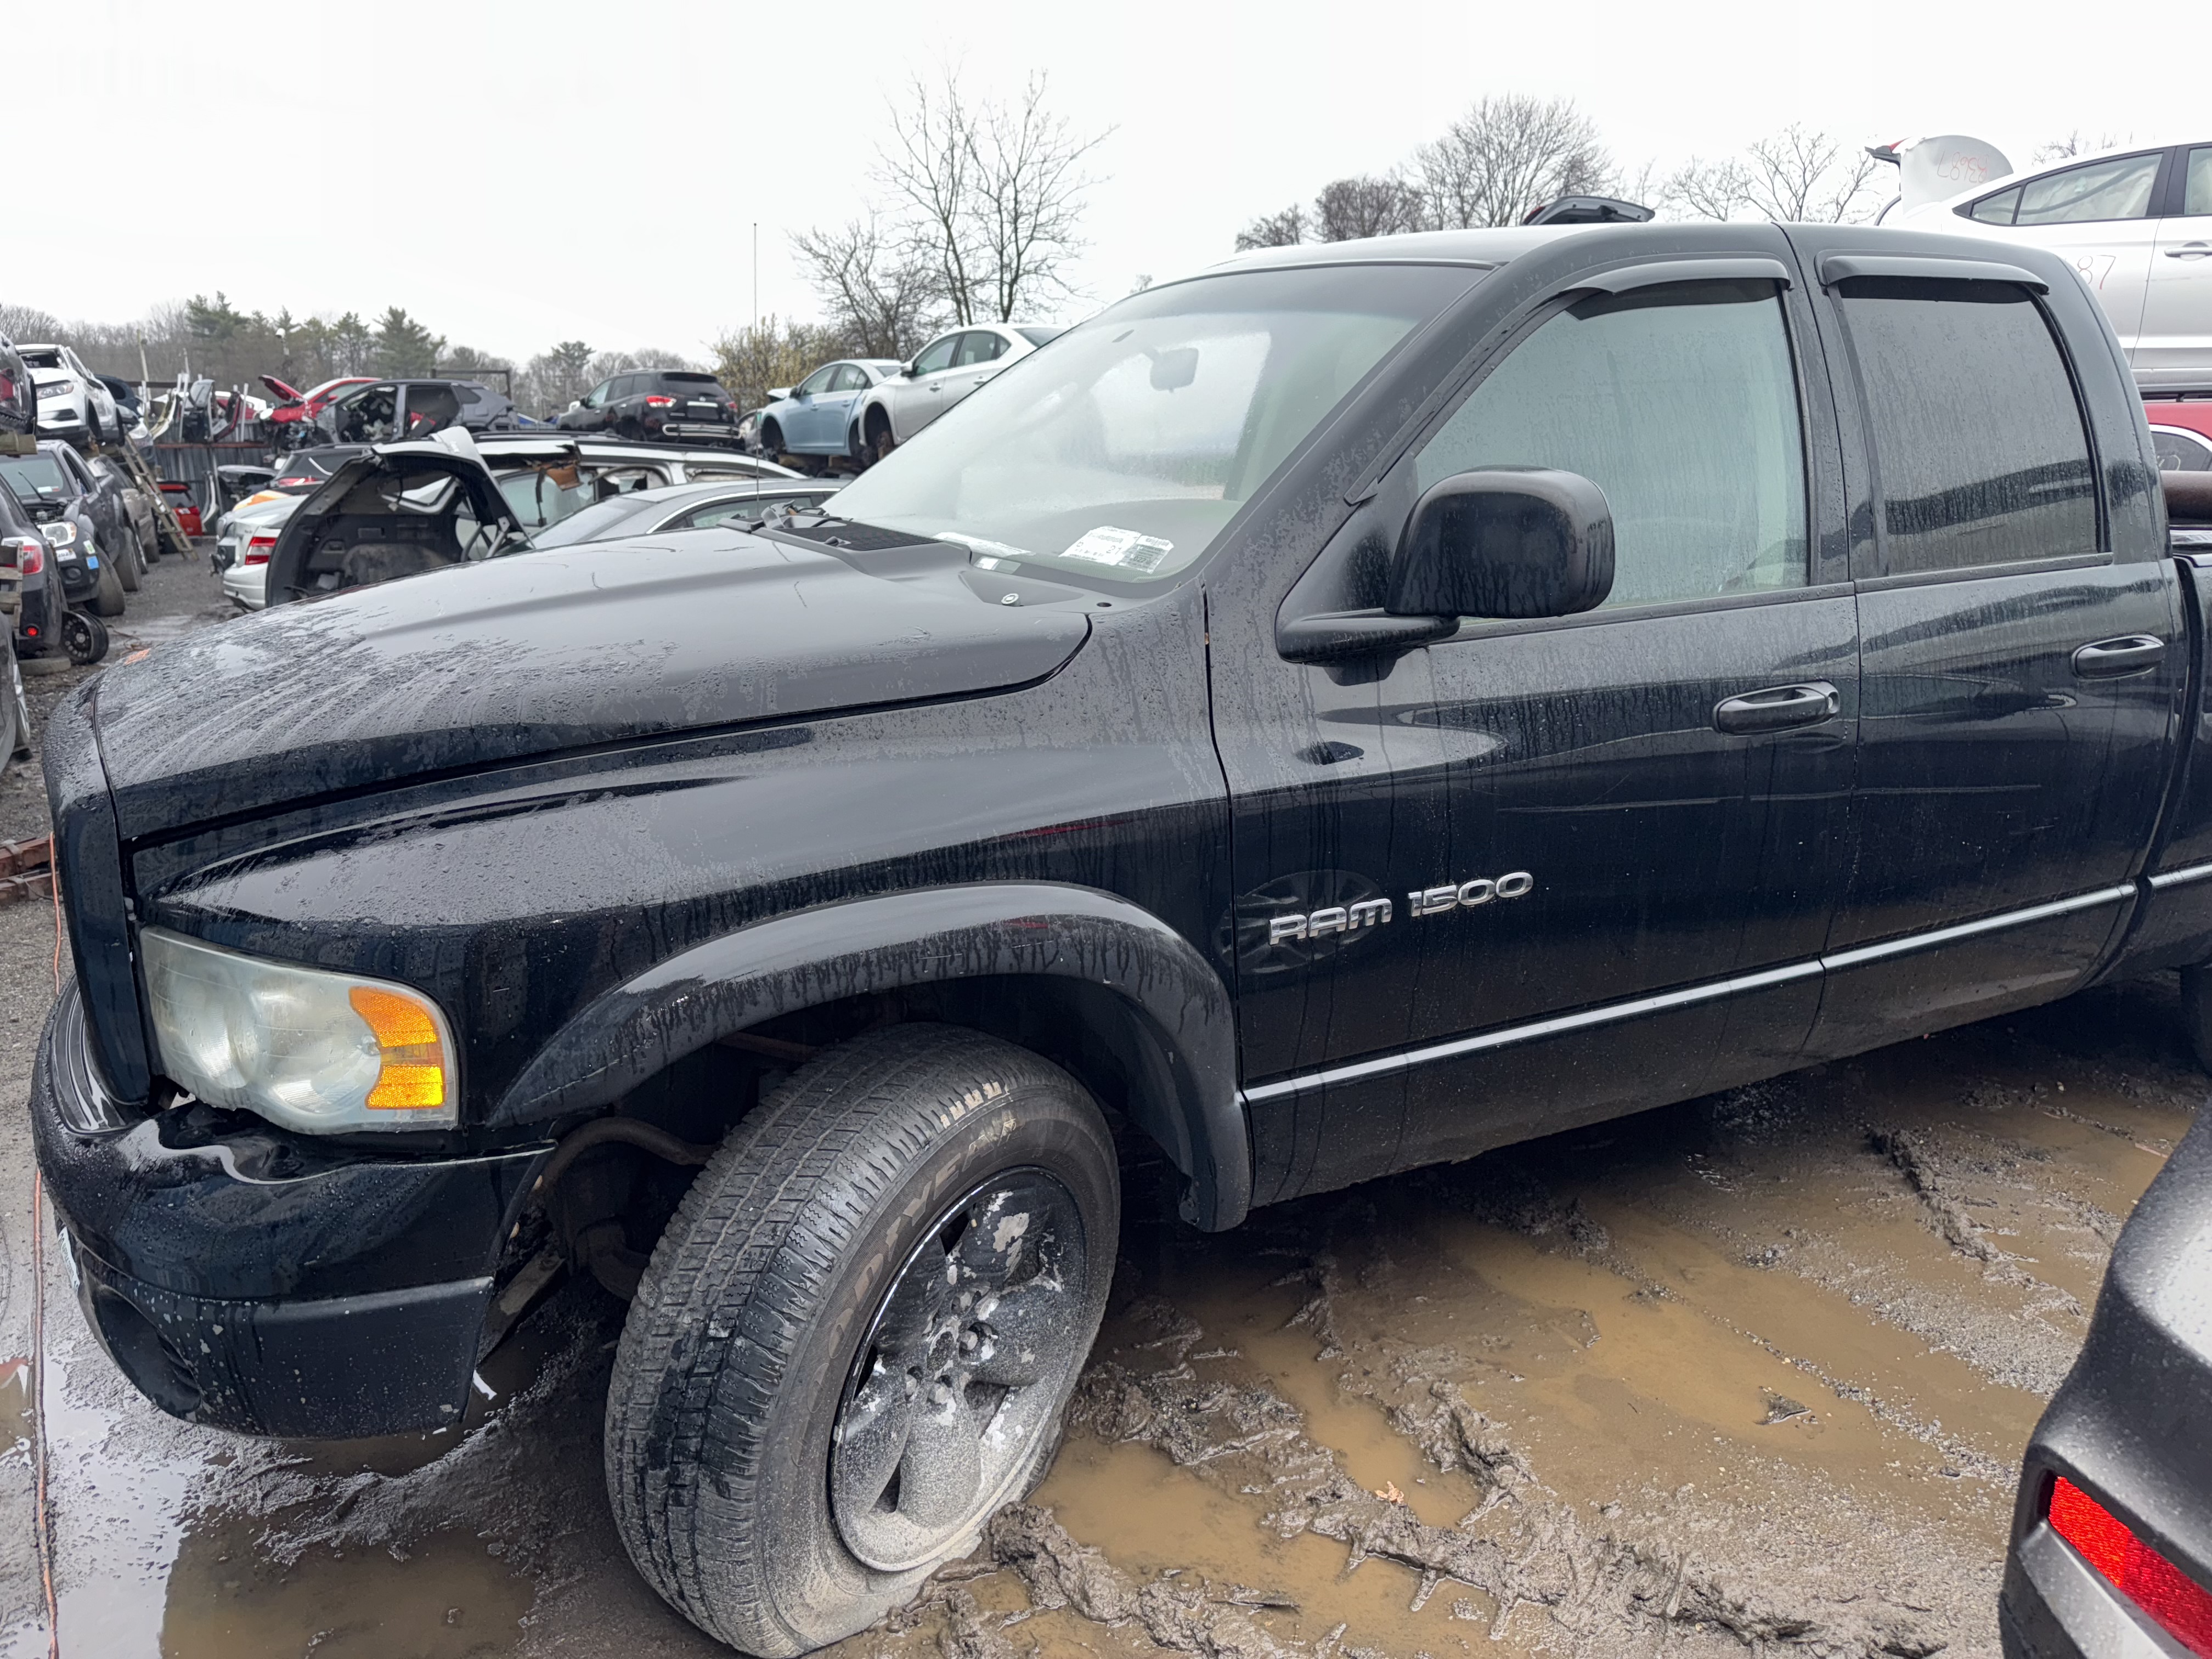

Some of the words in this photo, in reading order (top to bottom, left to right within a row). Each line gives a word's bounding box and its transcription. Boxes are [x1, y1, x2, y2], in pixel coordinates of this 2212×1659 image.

[2065, 255, 2117, 290] 87
[1268, 898, 1392, 945] RAM
[1408, 871, 1534, 917] 1500
